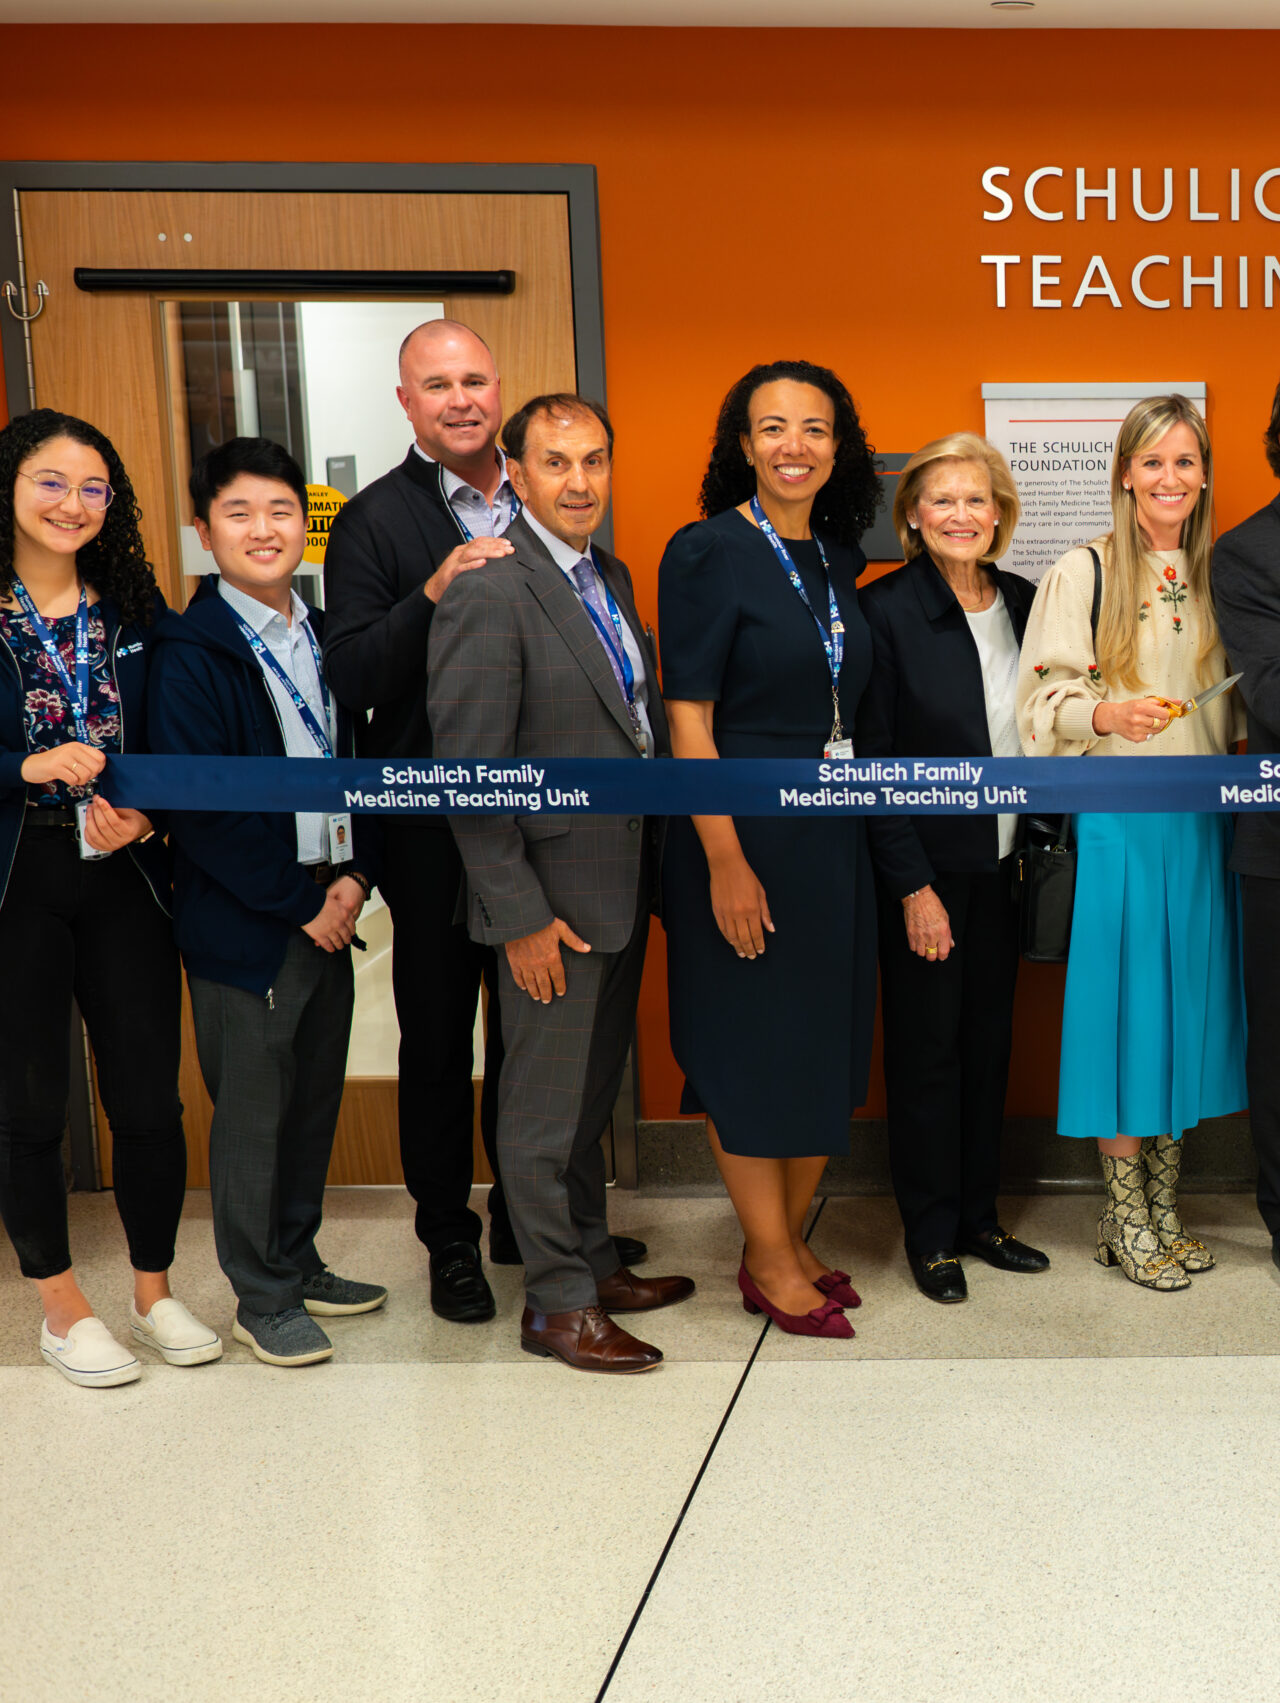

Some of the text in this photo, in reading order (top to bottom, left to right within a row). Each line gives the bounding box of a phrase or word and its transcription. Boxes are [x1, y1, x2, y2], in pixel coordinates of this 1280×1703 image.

[1009, 441, 1113, 454] THE SCHULICH
[1010, 459, 1107, 472] FOUNDATION
[1024, 480, 1059, 488] generosity
[1060, 479, 1067, 487] of
[1069, 479, 1081, 487] The
[1082, 479, 1109, 487] Schulich
[1038, 489, 1064, 497] Humber
[1066, 489, 1082, 497] River
[1083, 489, 1105, 497] Health
[1038, 500, 1059, 509] Family
[1060, 500, 1091, 508] Medicine
[1024, 510, 1039, 518] that
[1040, 510, 1052, 518] will
[1053, 510, 1078, 519] expand
[1079, 510, 1113, 518] fundamen
[1026, 538, 1070, 547] extraordinary
[1071, 538, 1084, 547] gift
[1012, 560, 1035, 568] quality
[382, 764, 545, 787] Schulich Family
[818, 761, 983, 785] Schulich Family
[344, 788, 590, 811] Medicine Teaching Unit
[779, 785, 1028, 810] Medicine Teaching Unit
